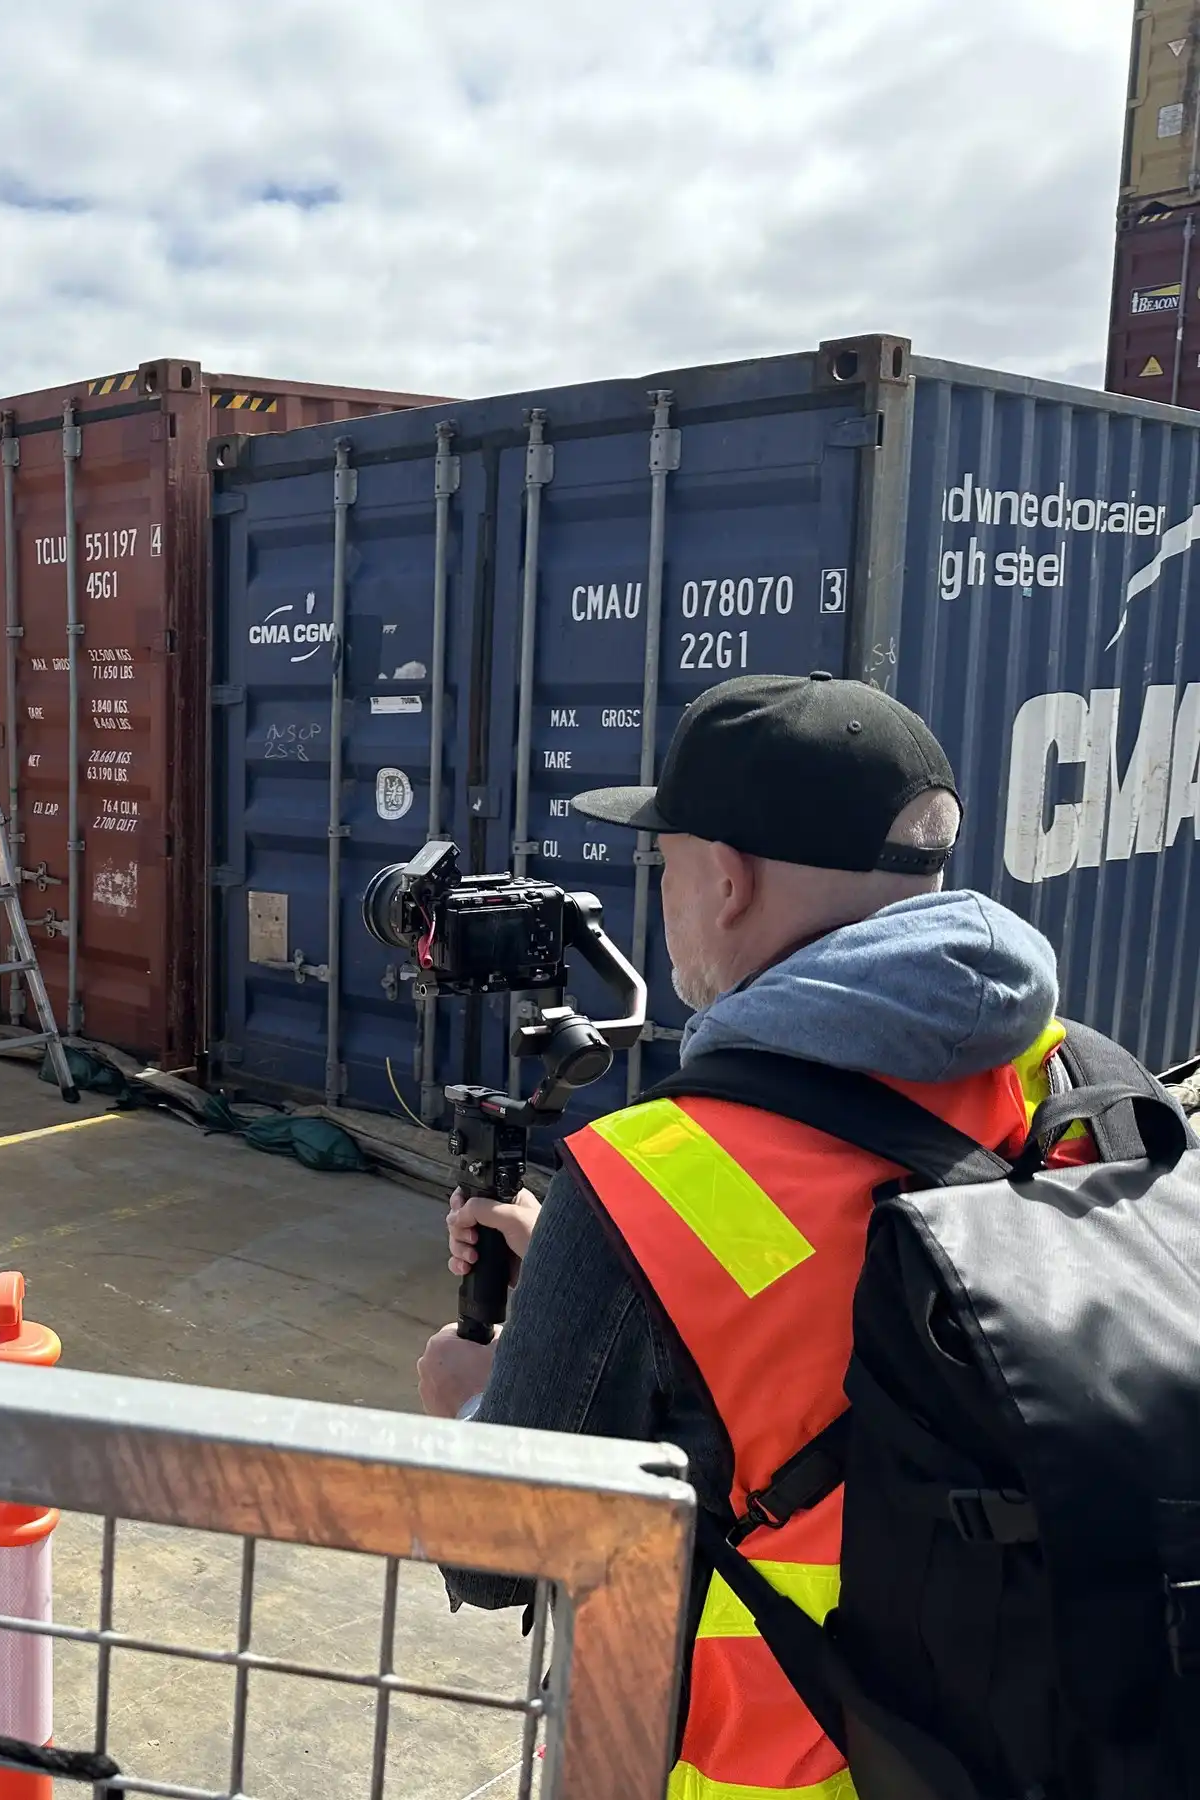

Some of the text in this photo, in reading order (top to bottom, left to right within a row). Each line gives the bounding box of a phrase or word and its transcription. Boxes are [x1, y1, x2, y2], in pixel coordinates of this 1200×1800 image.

[35, 525, 162, 565] TCLU 551197 4
[86, 571, 118, 599] 45G1
[571, 570, 844, 621] CMAU 078070 3
[249, 623, 335, 644] CMA CGM
[680, 630, 748, 669] 22G1
[550, 709, 579, 728] MAX.
[543, 751, 572, 769] TARE
[549, 799, 570, 817] NET
[542, 840, 610, 862] CU. CAP.
